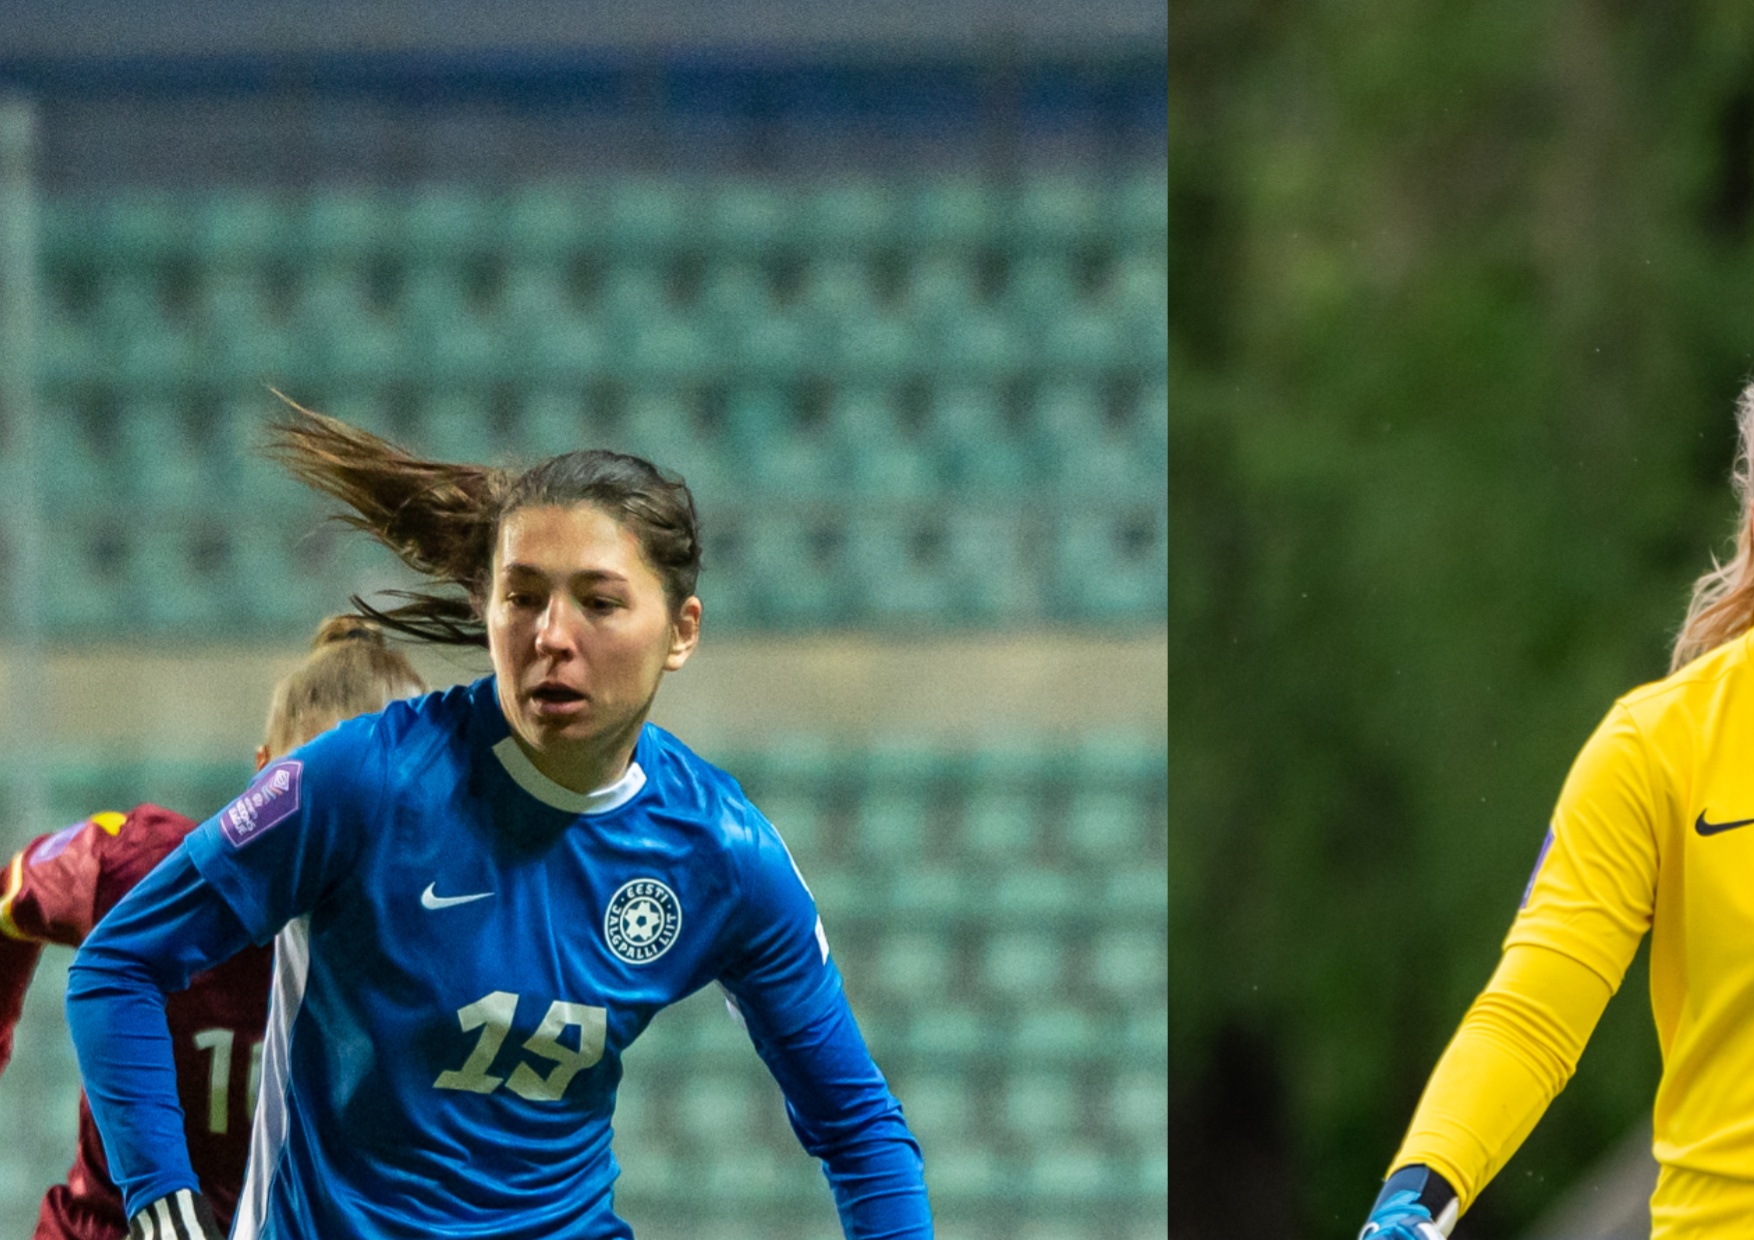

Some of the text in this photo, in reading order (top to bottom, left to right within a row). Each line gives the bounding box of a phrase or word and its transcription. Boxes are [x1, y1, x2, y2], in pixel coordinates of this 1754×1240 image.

[627, 884, 669, 903] EESTI
[609, 904, 677, 959] JALGPALLI LIIT
[433, 990, 607, 1101] 19
